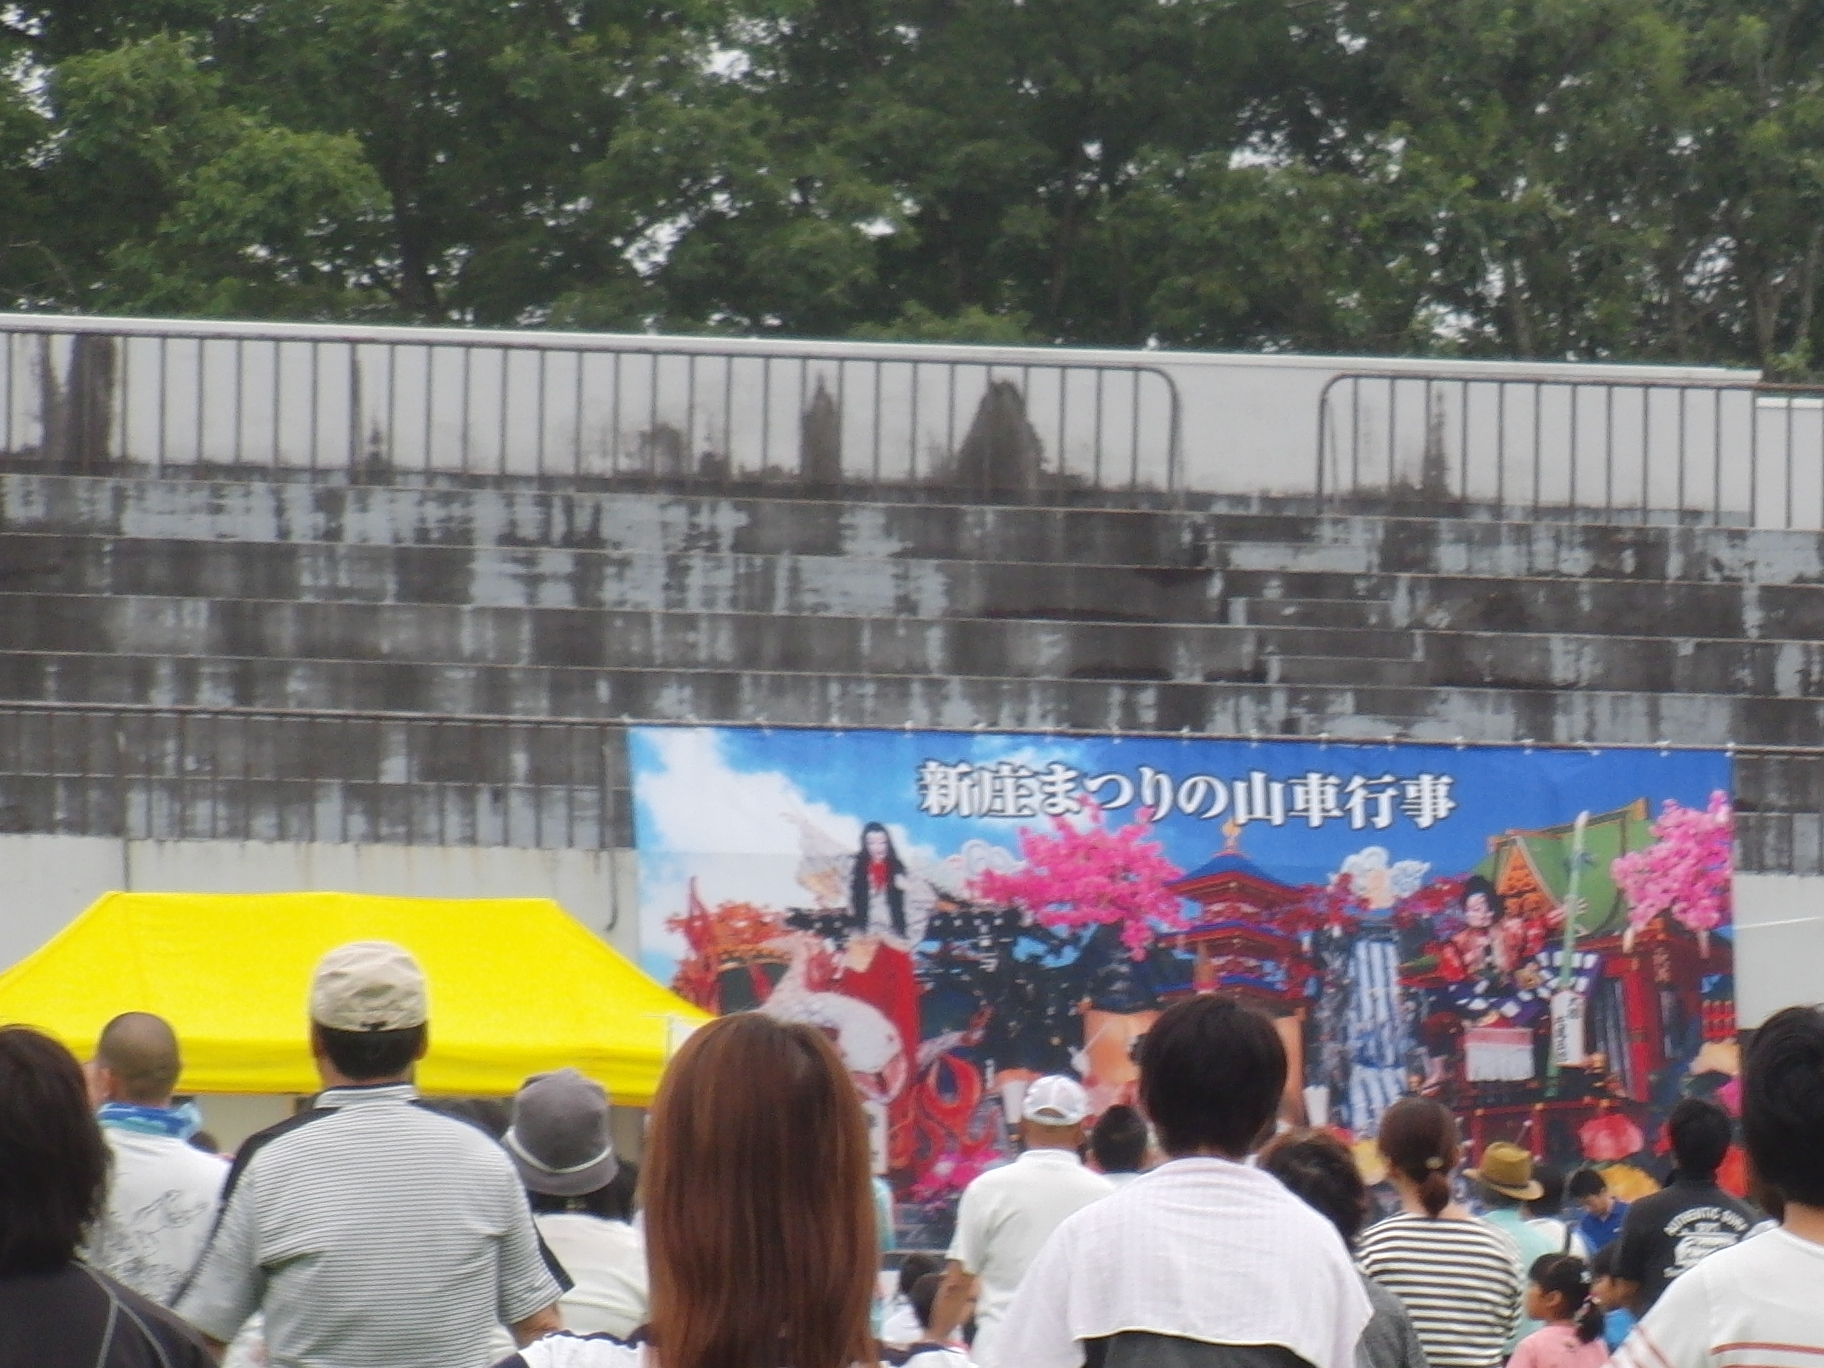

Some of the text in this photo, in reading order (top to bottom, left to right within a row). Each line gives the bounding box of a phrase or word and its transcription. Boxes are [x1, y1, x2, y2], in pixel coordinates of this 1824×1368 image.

[918, 759, 1457, 831] 新庄まつりの山車行事
